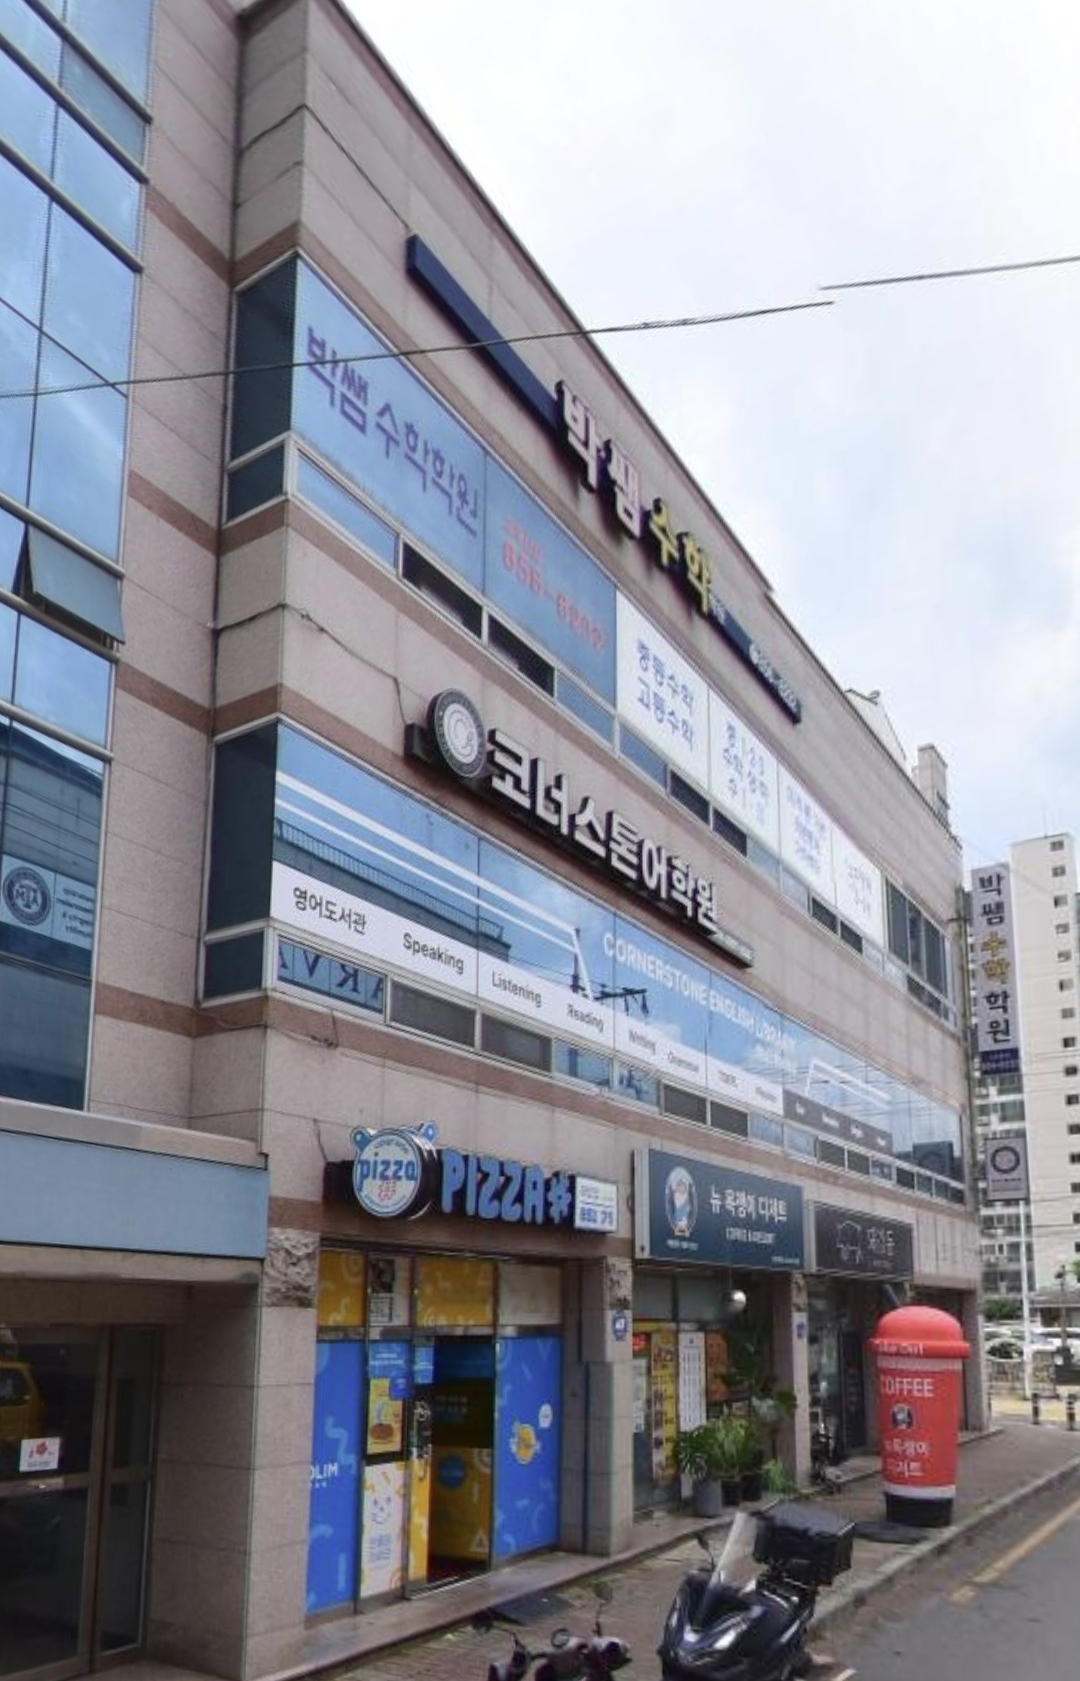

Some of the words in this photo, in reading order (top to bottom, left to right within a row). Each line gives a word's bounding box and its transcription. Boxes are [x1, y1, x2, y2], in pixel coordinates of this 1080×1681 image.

[491, 729, 718, 936] 코너스톤어학원
[293, 886, 367, 936] 영어도서관
[403, 932, 464, 975] Speaking
[492, 971, 541, 1008] Listening
[567, 1003, 604, 1033] Reading
[604, 932, 707, 1006] CORNERSTONE
[357, 1152, 418, 1194] pizza
